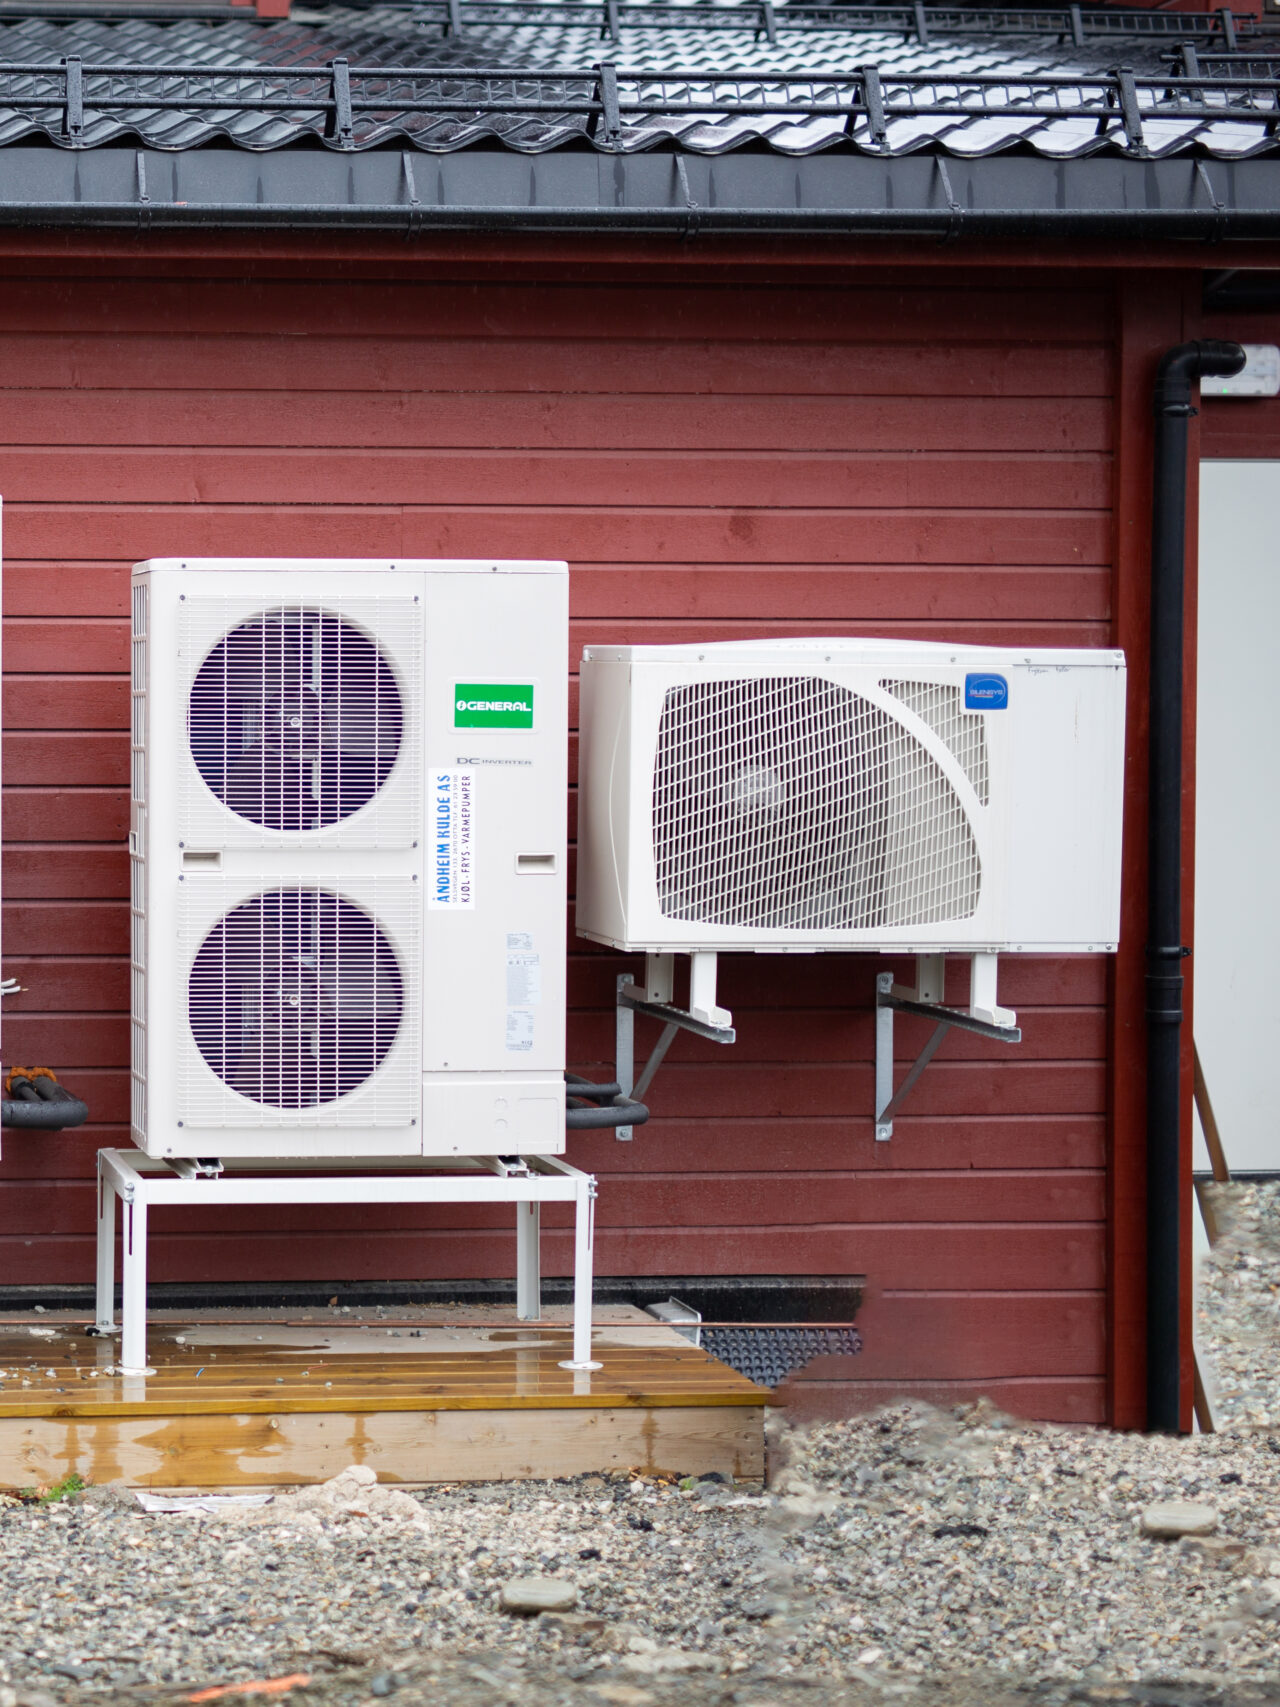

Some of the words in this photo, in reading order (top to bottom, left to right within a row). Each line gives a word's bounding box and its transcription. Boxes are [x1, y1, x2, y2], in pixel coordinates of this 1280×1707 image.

[467, 700, 532, 712] GENERAL
[437, 775, 450, 791] AS
[437, 797, 450, 838] KULDE
[462, 775, 470, 844] VARMEPUMPER
[432, 843, 450, 902] ÅNDHEIM
[461, 852, 470, 872] FRYS
[461, 881, 470, 903] KJØL
